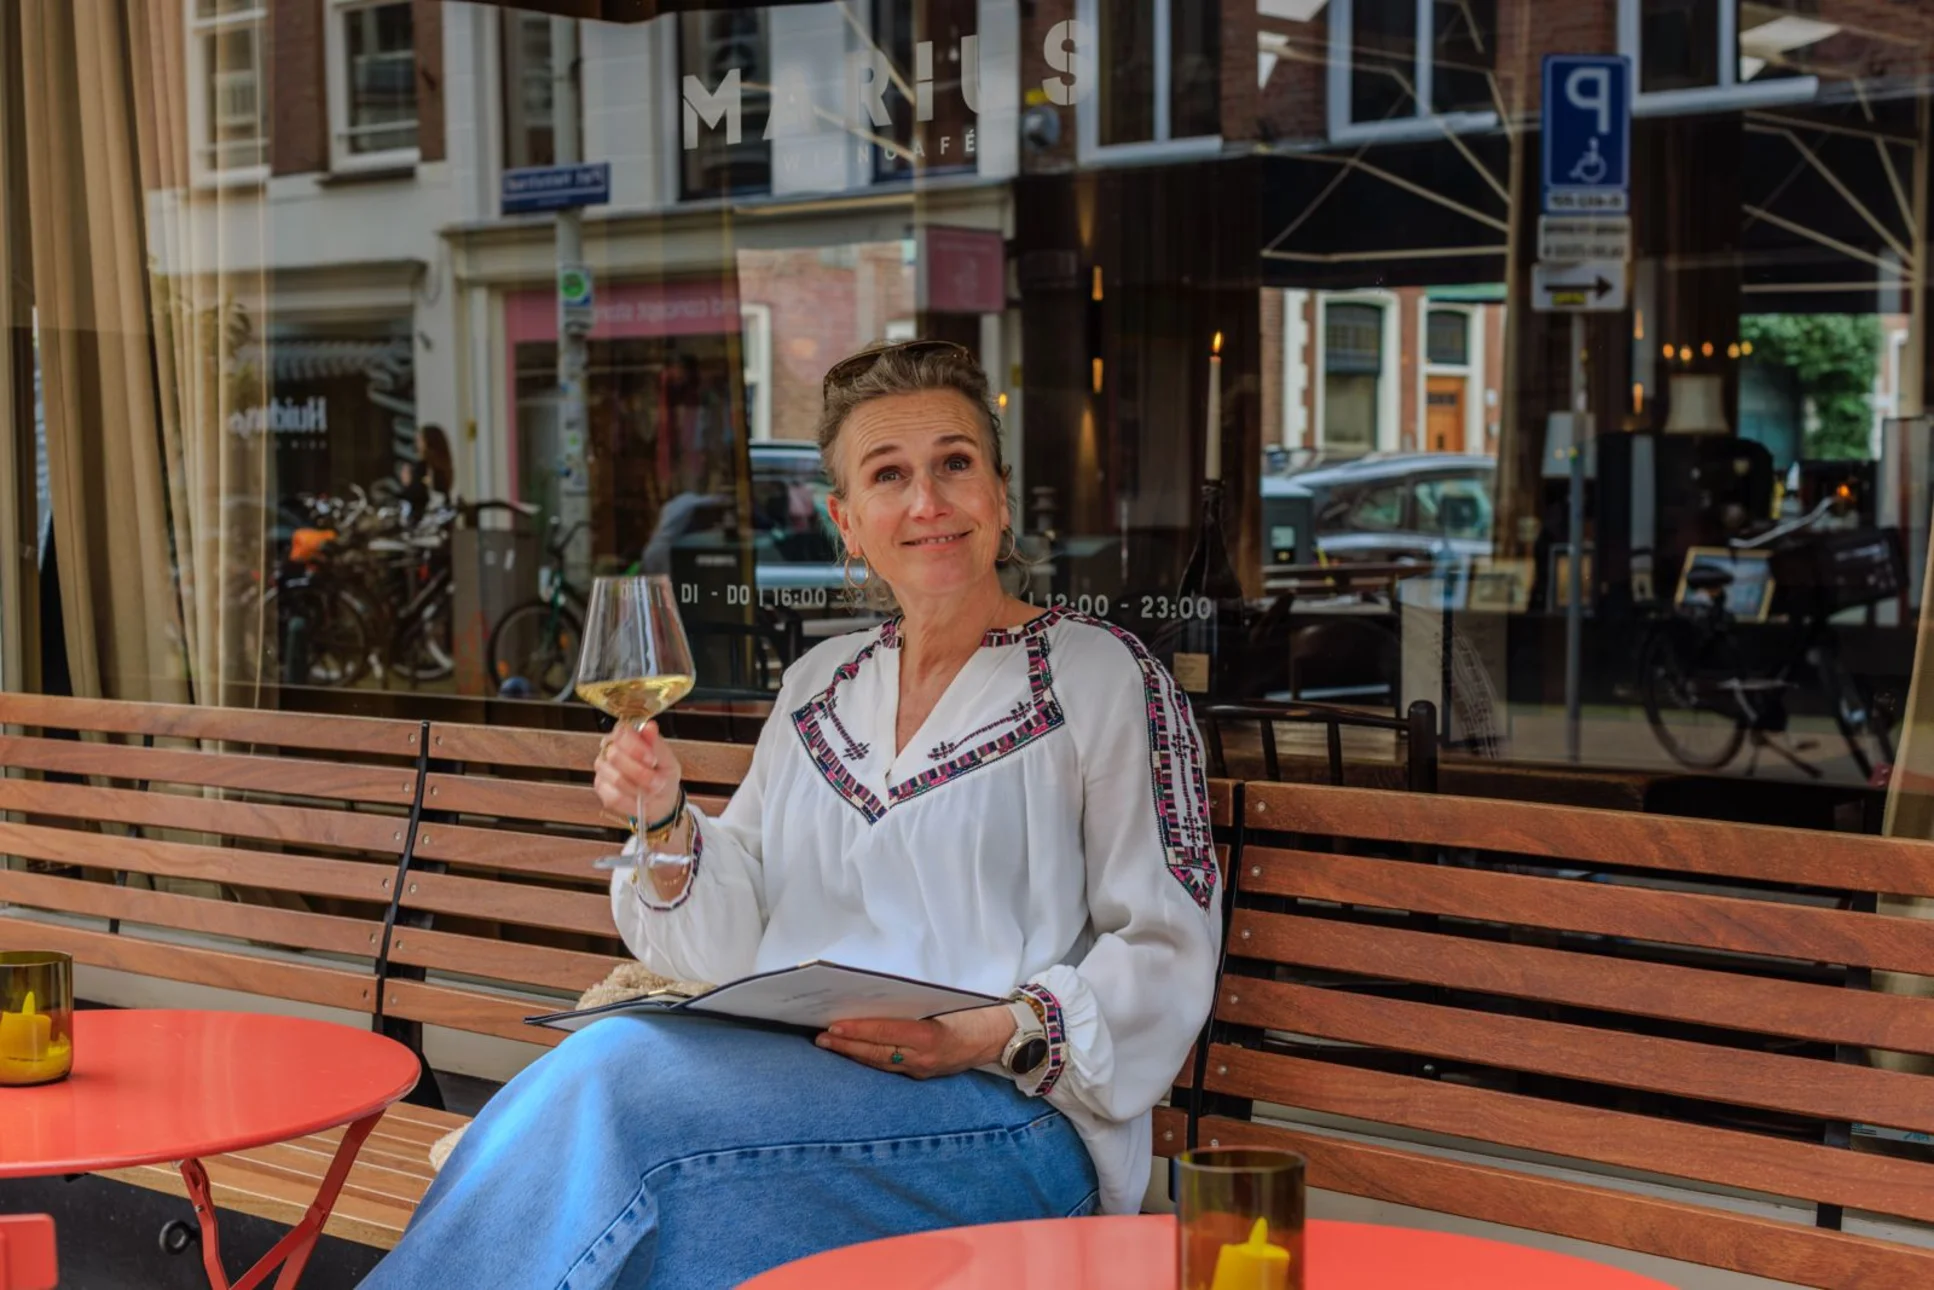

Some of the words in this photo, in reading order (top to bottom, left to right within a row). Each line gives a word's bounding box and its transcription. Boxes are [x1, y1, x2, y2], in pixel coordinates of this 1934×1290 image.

[682, 19, 1095, 150] MARIUS
[681, 583, 699, 604] DI
[727, 584, 750, 605] DO
[772, 588, 827, 607] 16:00
[1141, 595, 1212, 620] 23:00
